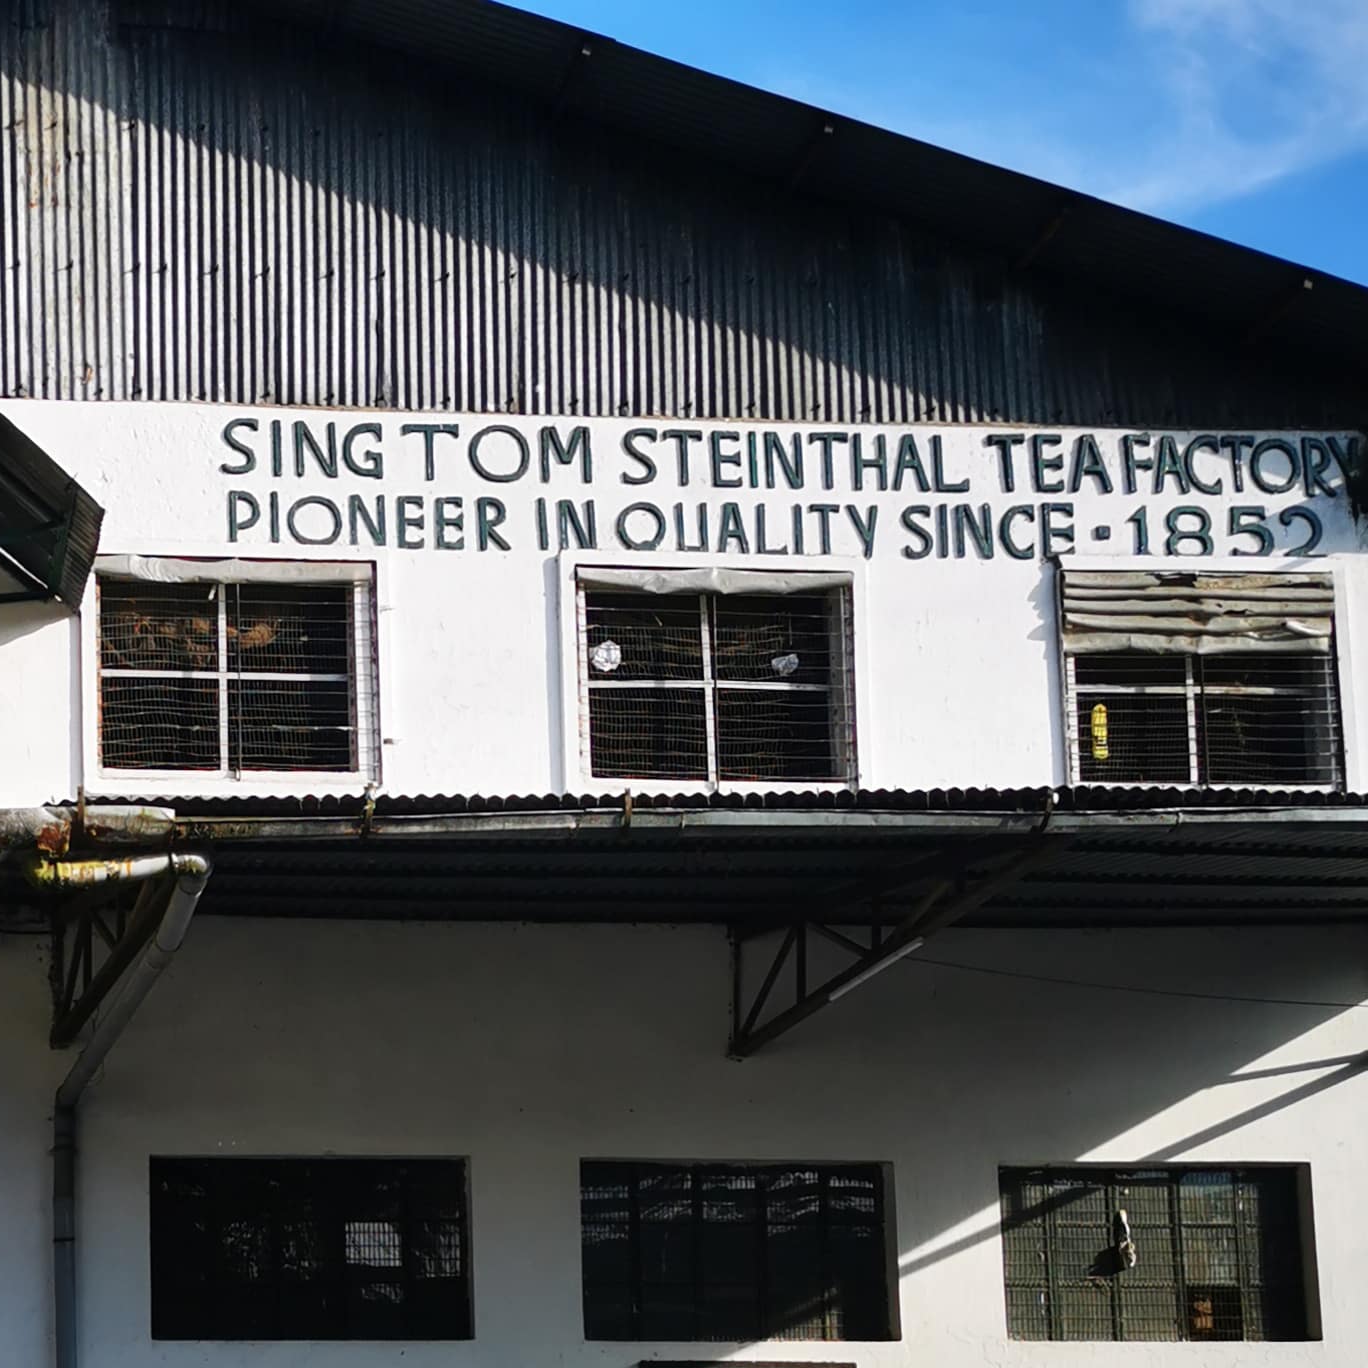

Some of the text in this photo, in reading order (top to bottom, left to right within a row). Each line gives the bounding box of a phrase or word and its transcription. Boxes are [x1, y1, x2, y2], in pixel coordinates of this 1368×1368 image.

[620, 427, 971, 493] STEINTHAL
[986, 434, 1114, 495] TEA
[1118, 434, 1360, 498] FACTORY
[226, 489, 513, 552] PIONEER
[536, 496, 597, 551] IN
[614, 500, 880, 560] QUALITY
